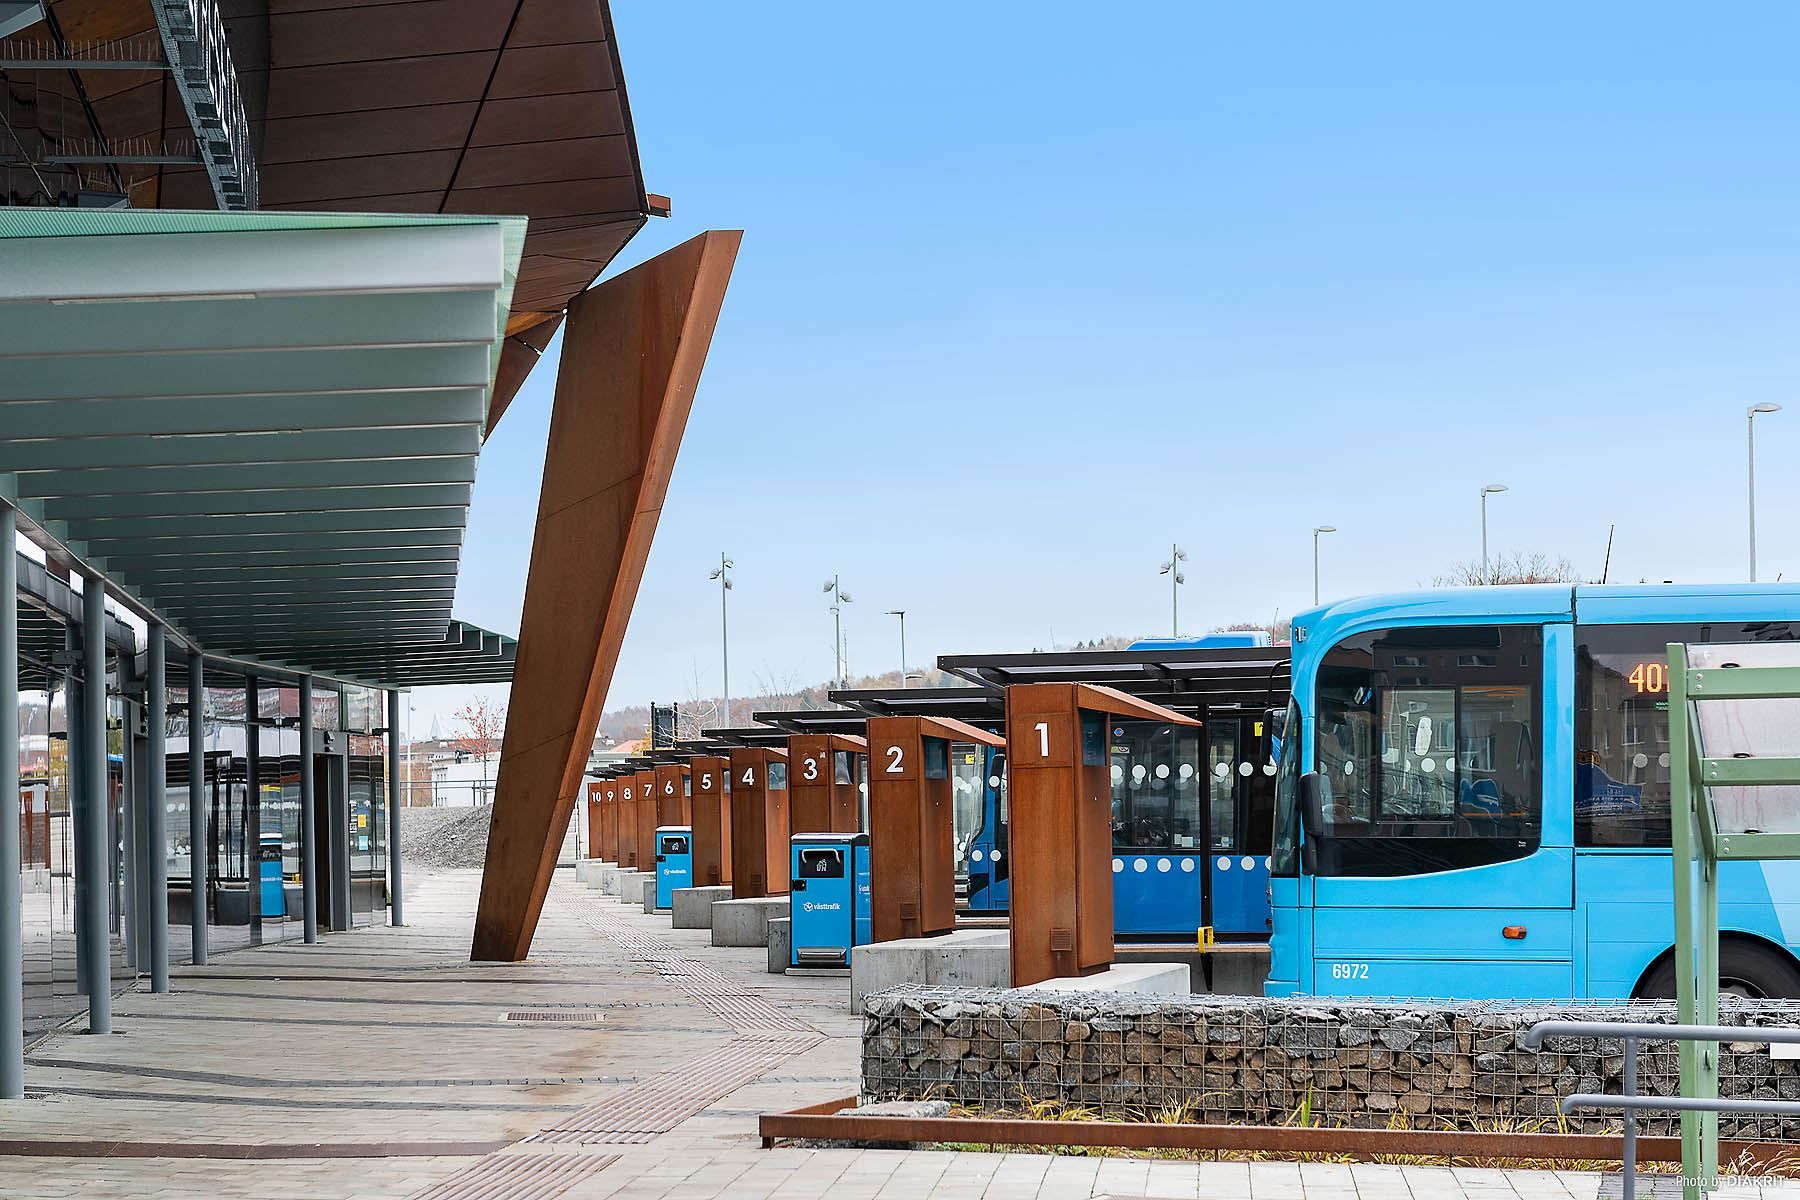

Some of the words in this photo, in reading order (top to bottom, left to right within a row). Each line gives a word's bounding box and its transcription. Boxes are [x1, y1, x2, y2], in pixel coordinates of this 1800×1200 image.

[1034, 722, 1049, 757] 1
[886, 746, 904, 773] 2
[741, 768, 755, 786] 4
[803, 758, 818, 780] 3
[664, 780, 674, 795] 6
[701, 773, 712, 790] 5
[591, 792, 602, 802] 10
[606, 791, 614, 801] 9
[623, 788, 632, 800] 8
[644, 784, 653, 797] 7
[1332, 963, 1369, 979] 6972
